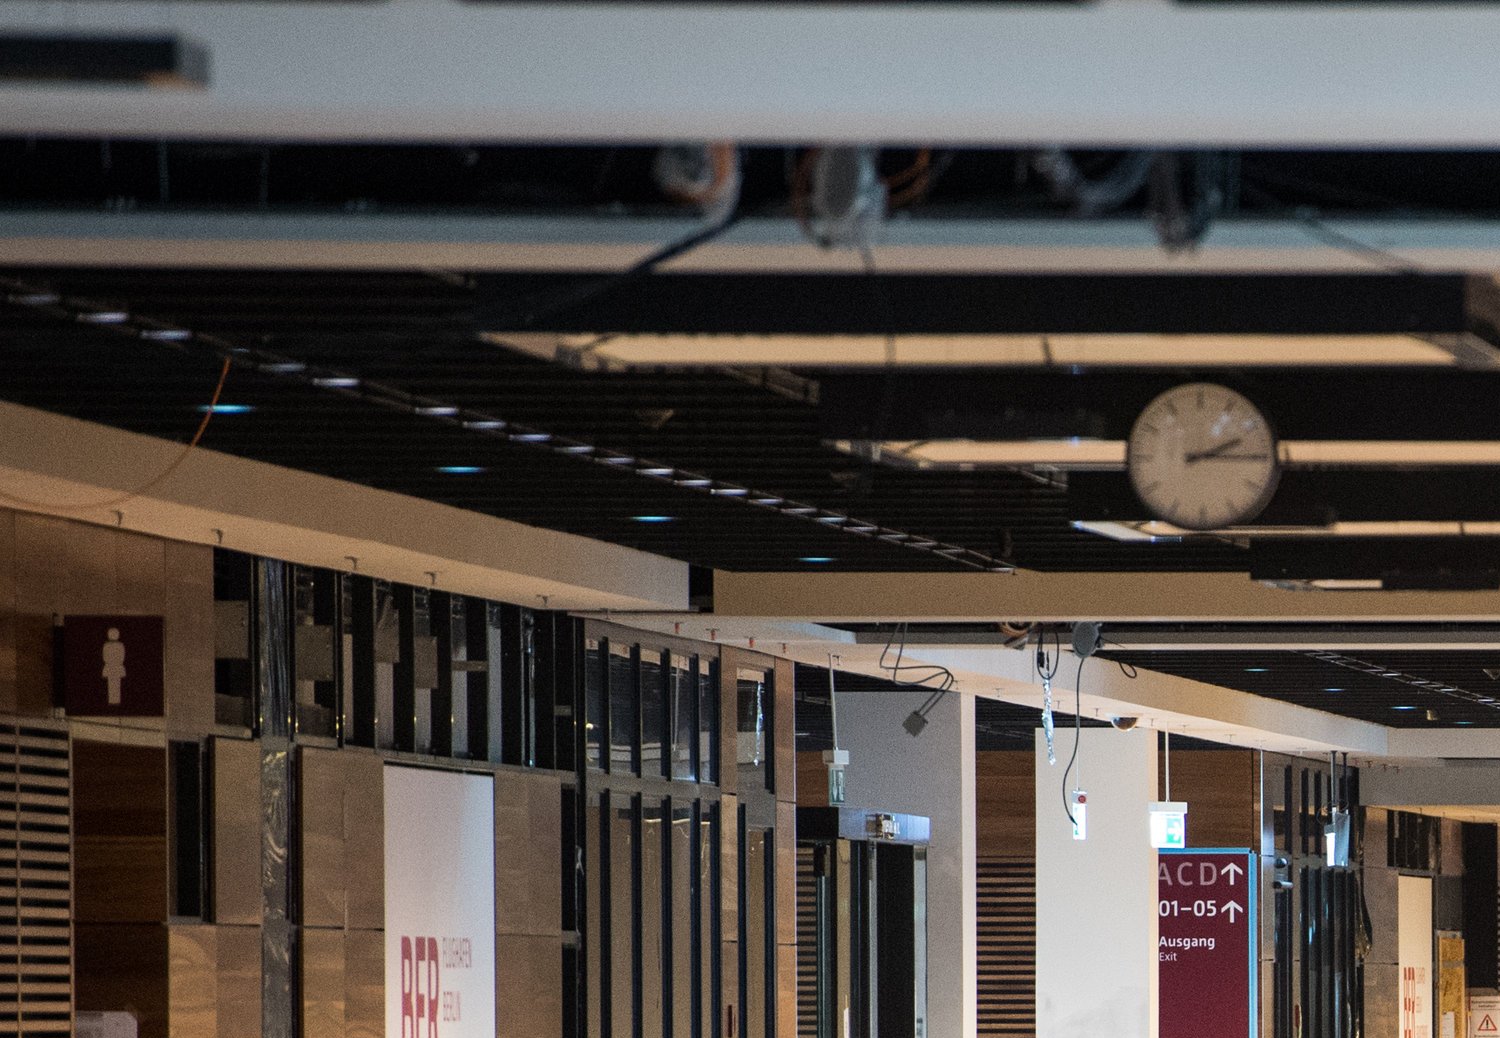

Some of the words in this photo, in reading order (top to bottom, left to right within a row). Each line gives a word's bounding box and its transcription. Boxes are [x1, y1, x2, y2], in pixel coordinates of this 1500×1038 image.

[442, 936, 473, 968] FLUGHAFEN
[1158, 936, 1215, 950] Ausgang
[1159, 952, 1177, 961] Exit
[443, 991, 461, 1022] BERLIN
